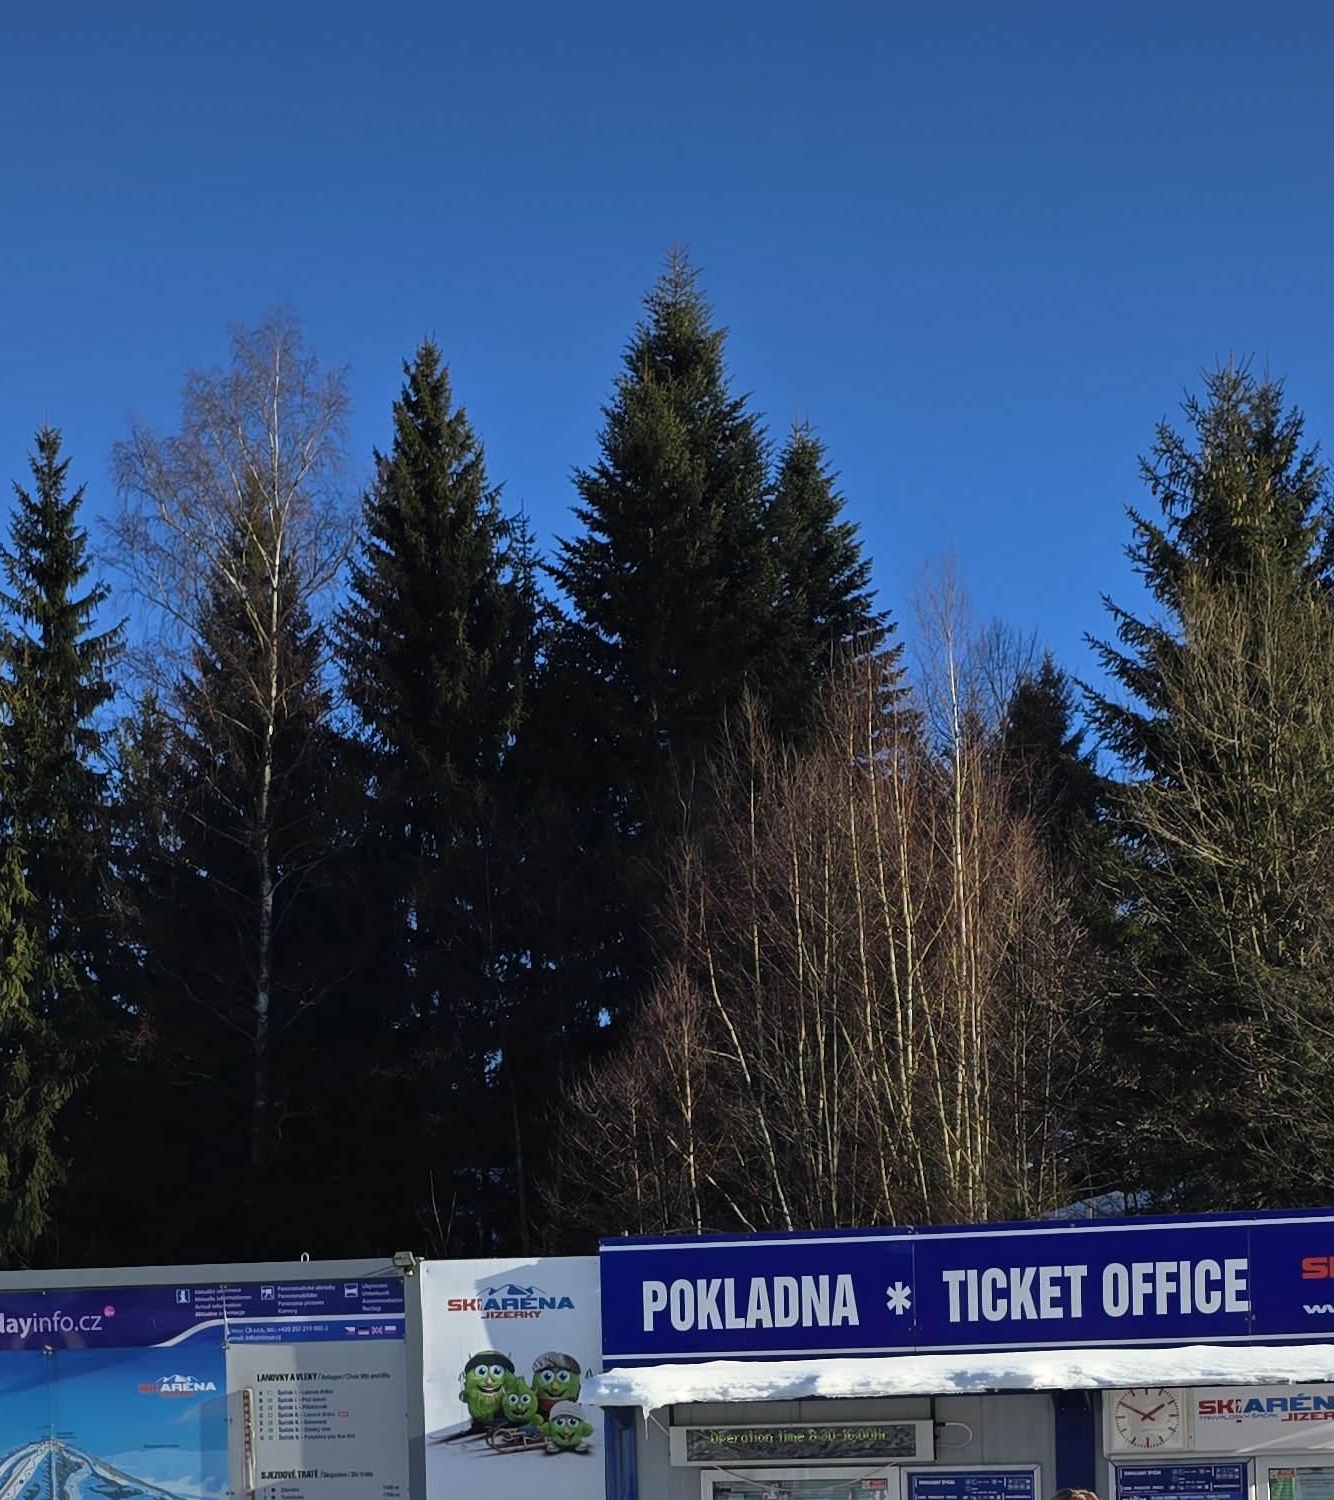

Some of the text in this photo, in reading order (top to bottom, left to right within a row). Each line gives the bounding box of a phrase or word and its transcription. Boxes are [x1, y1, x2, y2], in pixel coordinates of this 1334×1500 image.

[642, 1258, 1250, 1333] POKLADNA TICKET OFFICE
[480, 1310, 542, 1320] JIZERKY
[257, 1373, 289, 1382] LANOVKY
[295, 1372, 318, 1381] VLEKY
[710, 1431, 774, 1444] Operation
[778, 1430, 806, 1442] time
